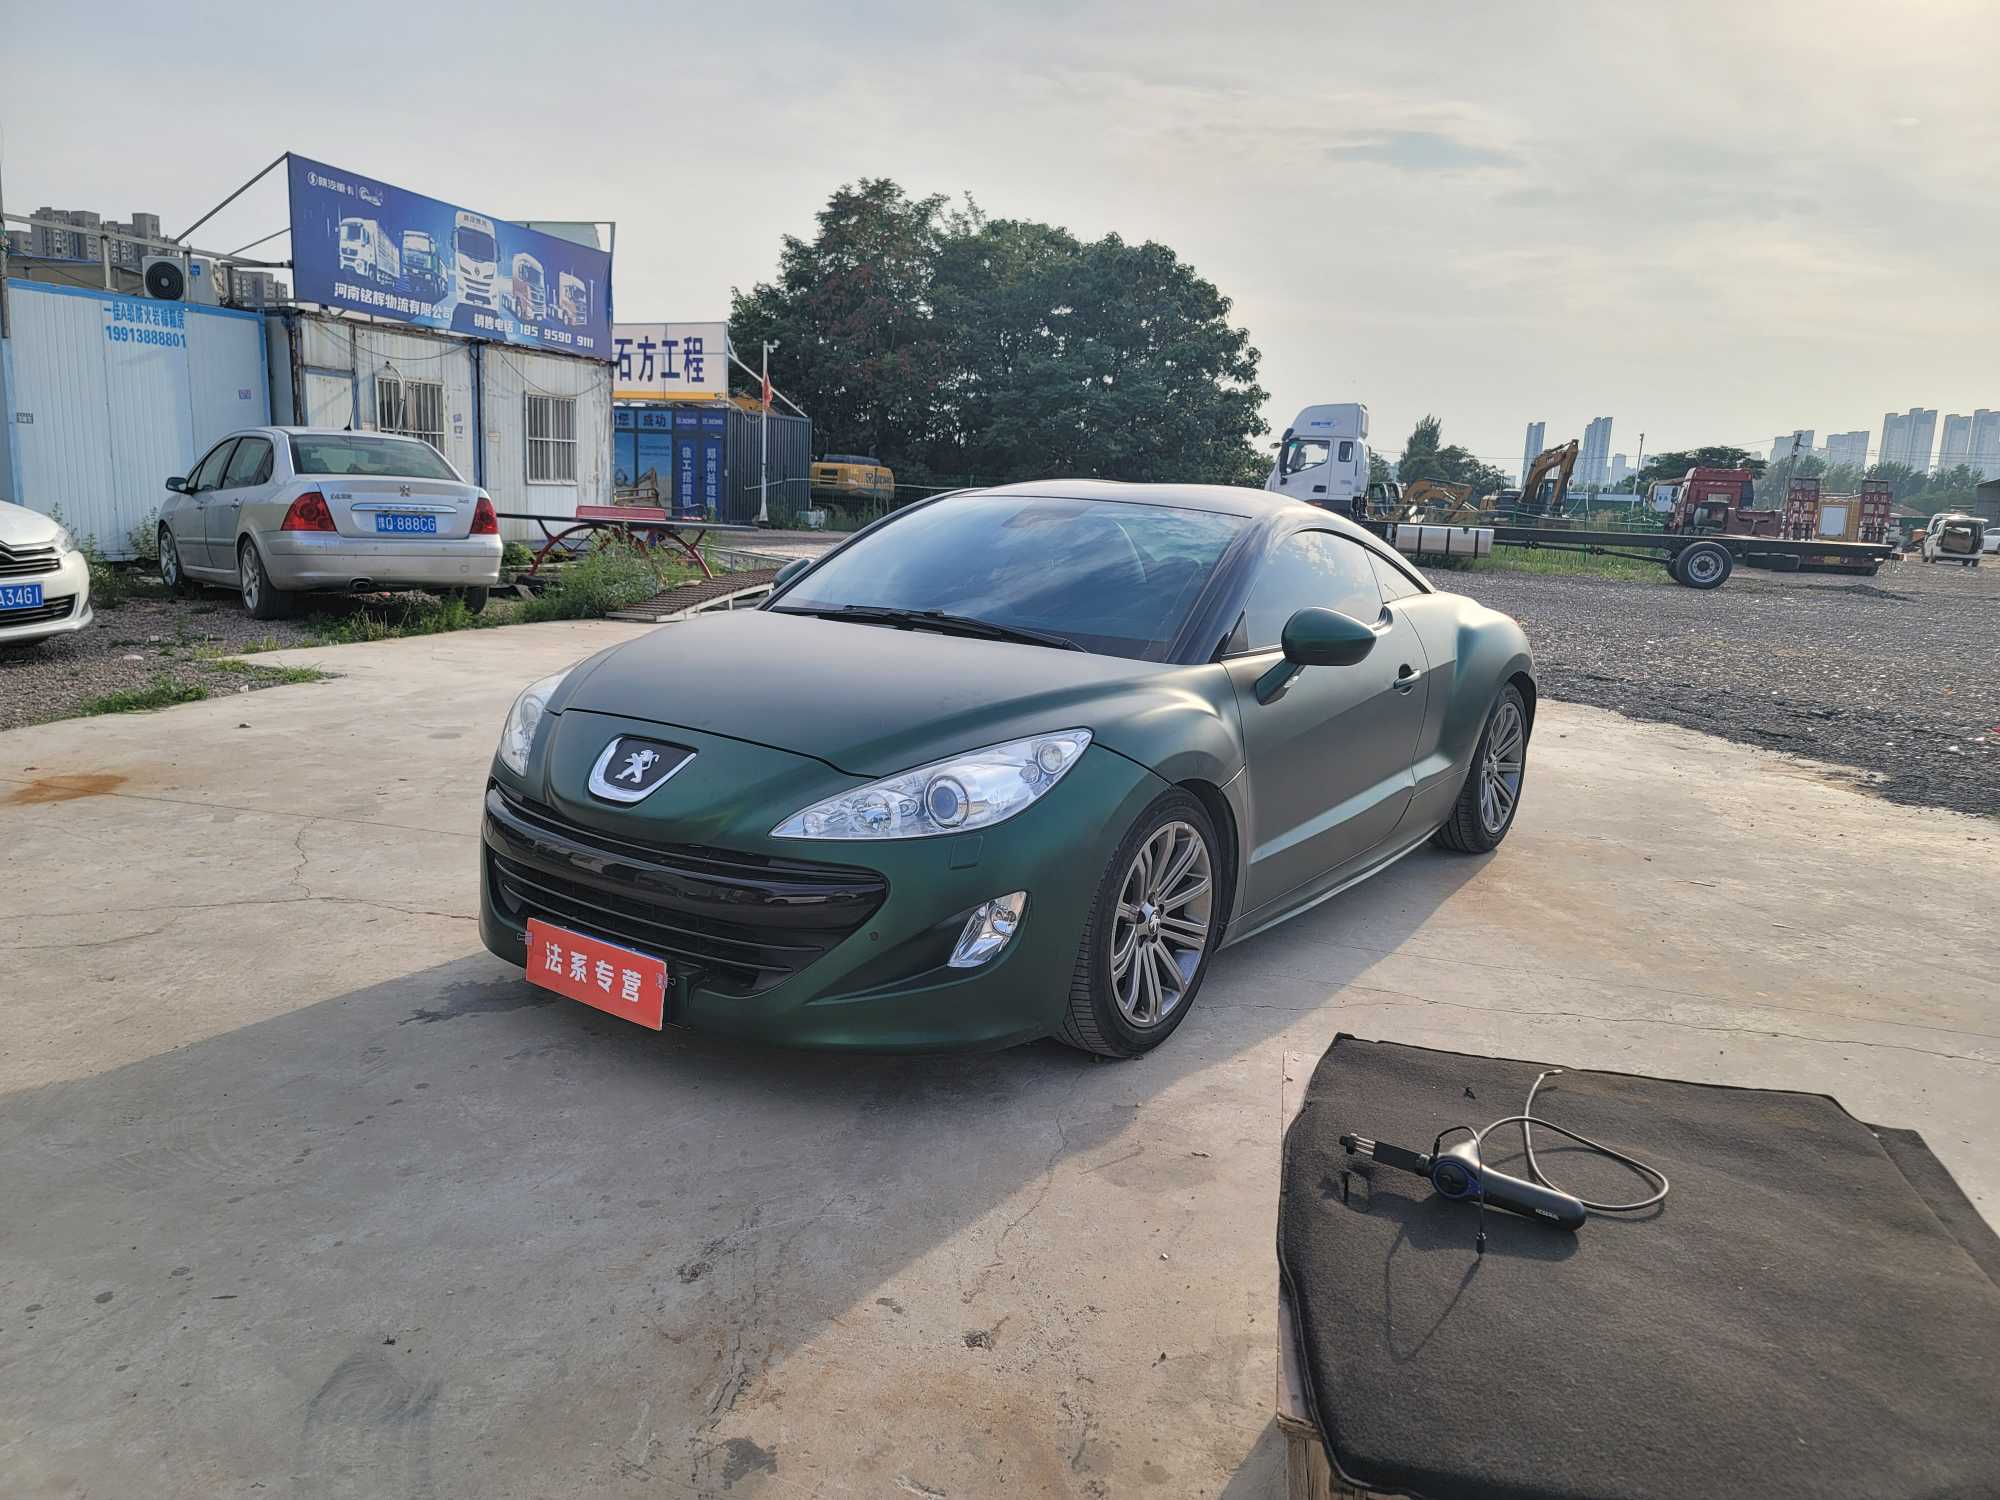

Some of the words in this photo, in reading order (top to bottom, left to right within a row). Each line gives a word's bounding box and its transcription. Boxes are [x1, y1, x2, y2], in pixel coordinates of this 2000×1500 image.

[334, 282, 453, 319] 河南铭辉物流有限公司
[105, 325, 186, 348] 19913888801
[474, 313, 513, 334] 销售电话
[520, 323, 539, 337] 185
[544, 328, 572, 344] 9590
[577, 335, 594, 348] 9111
[614, 336, 705, 383] 石方工程
[545, 941, 642, 1003] 法系专营
